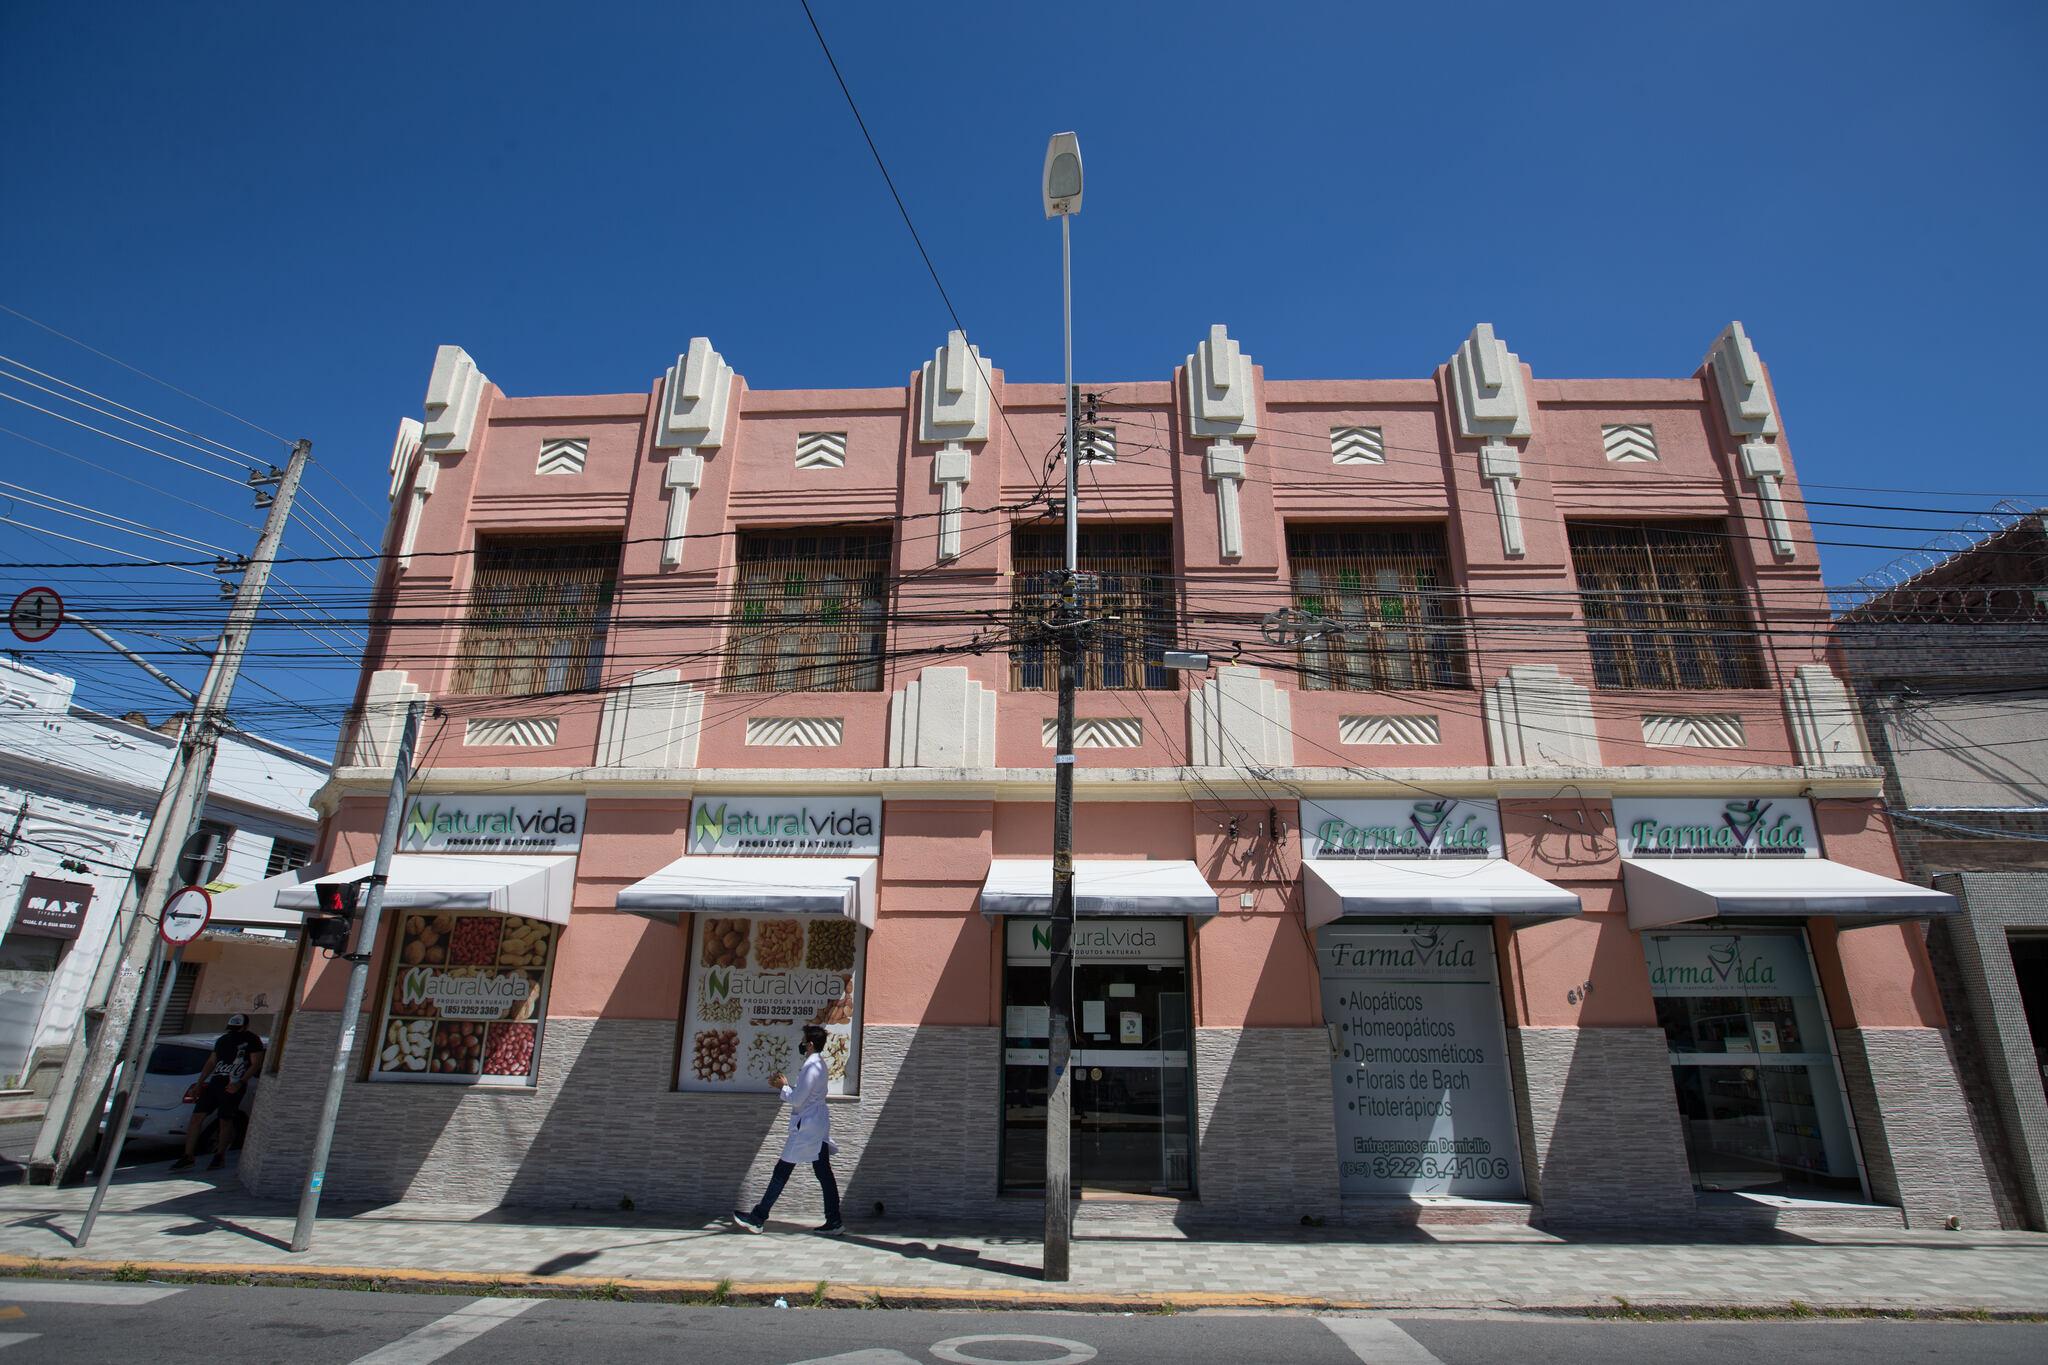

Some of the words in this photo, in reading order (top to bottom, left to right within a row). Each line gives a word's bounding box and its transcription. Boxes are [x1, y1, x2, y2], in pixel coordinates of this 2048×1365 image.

[406, 801, 576, 843] Naturalvida
[695, 803, 874, 843] Naturalvida
[446, 838, 500, 846] PRODUTOS
[504, 839, 557, 847] NATURAIS
[738, 840, 795, 848] PRODUTOS
[799, 840, 854, 848] NATURAIS
[27, 897, 80, 914] MAX
[1032, 923, 1157, 951] Nuralvida
[1647, 950, 1776, 984] armaVida
[407, 970, 527, 1000] Naturalvida
[708, 969, 842, 1000] Naturalvida
[461, 1005, 479, 1015] 3252
[480, 1006, 500, 1015] 3369
[753, 1005, 770, 1015] (85)
[771, 1006, 791, 1015] 3252
[792, 1006, 814, 1016] 3369
[1349, 990, 1424, 1015] Alopáticos
[1352, 1016, 1456, 1041] Homeopáticos
[1354, 1043, 1484, 1064] Dermocosméticos
[1356, 1068, 1405, 1090] Florais
[1409, 1069, 1428, 1090] de
[1433, 1069, 1471, 1090] Bach
[1358, 1095, 1453, 1121] Fitoterápicos
[1354, 1136, 1419, 1156] Entregamos
[1421, 1141, 1439, 1153] em
[1373, 1157, 1510, 1180] 3226.4106
